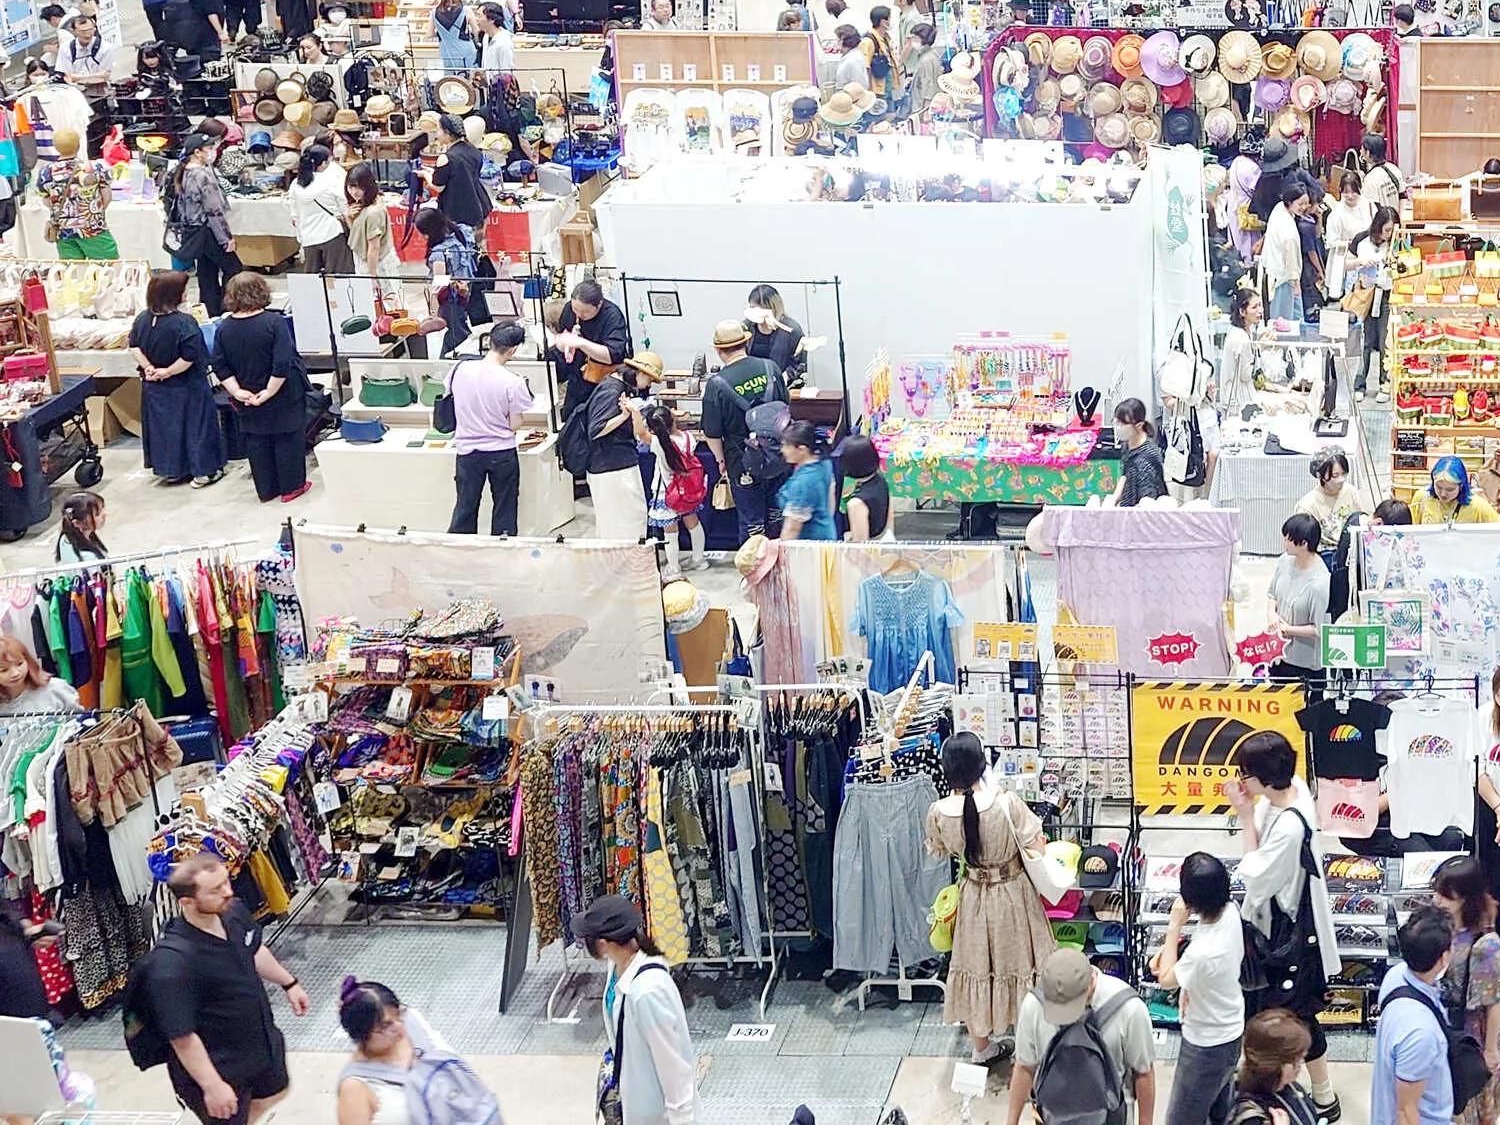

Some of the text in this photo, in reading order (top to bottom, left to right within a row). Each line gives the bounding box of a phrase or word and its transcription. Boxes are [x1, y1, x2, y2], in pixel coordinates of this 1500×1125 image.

[1151, 641, 1195, 656] STOP!
[1157, 695, 1282, 716] WARNING
[732, 1027, 769, 1037] J-370
